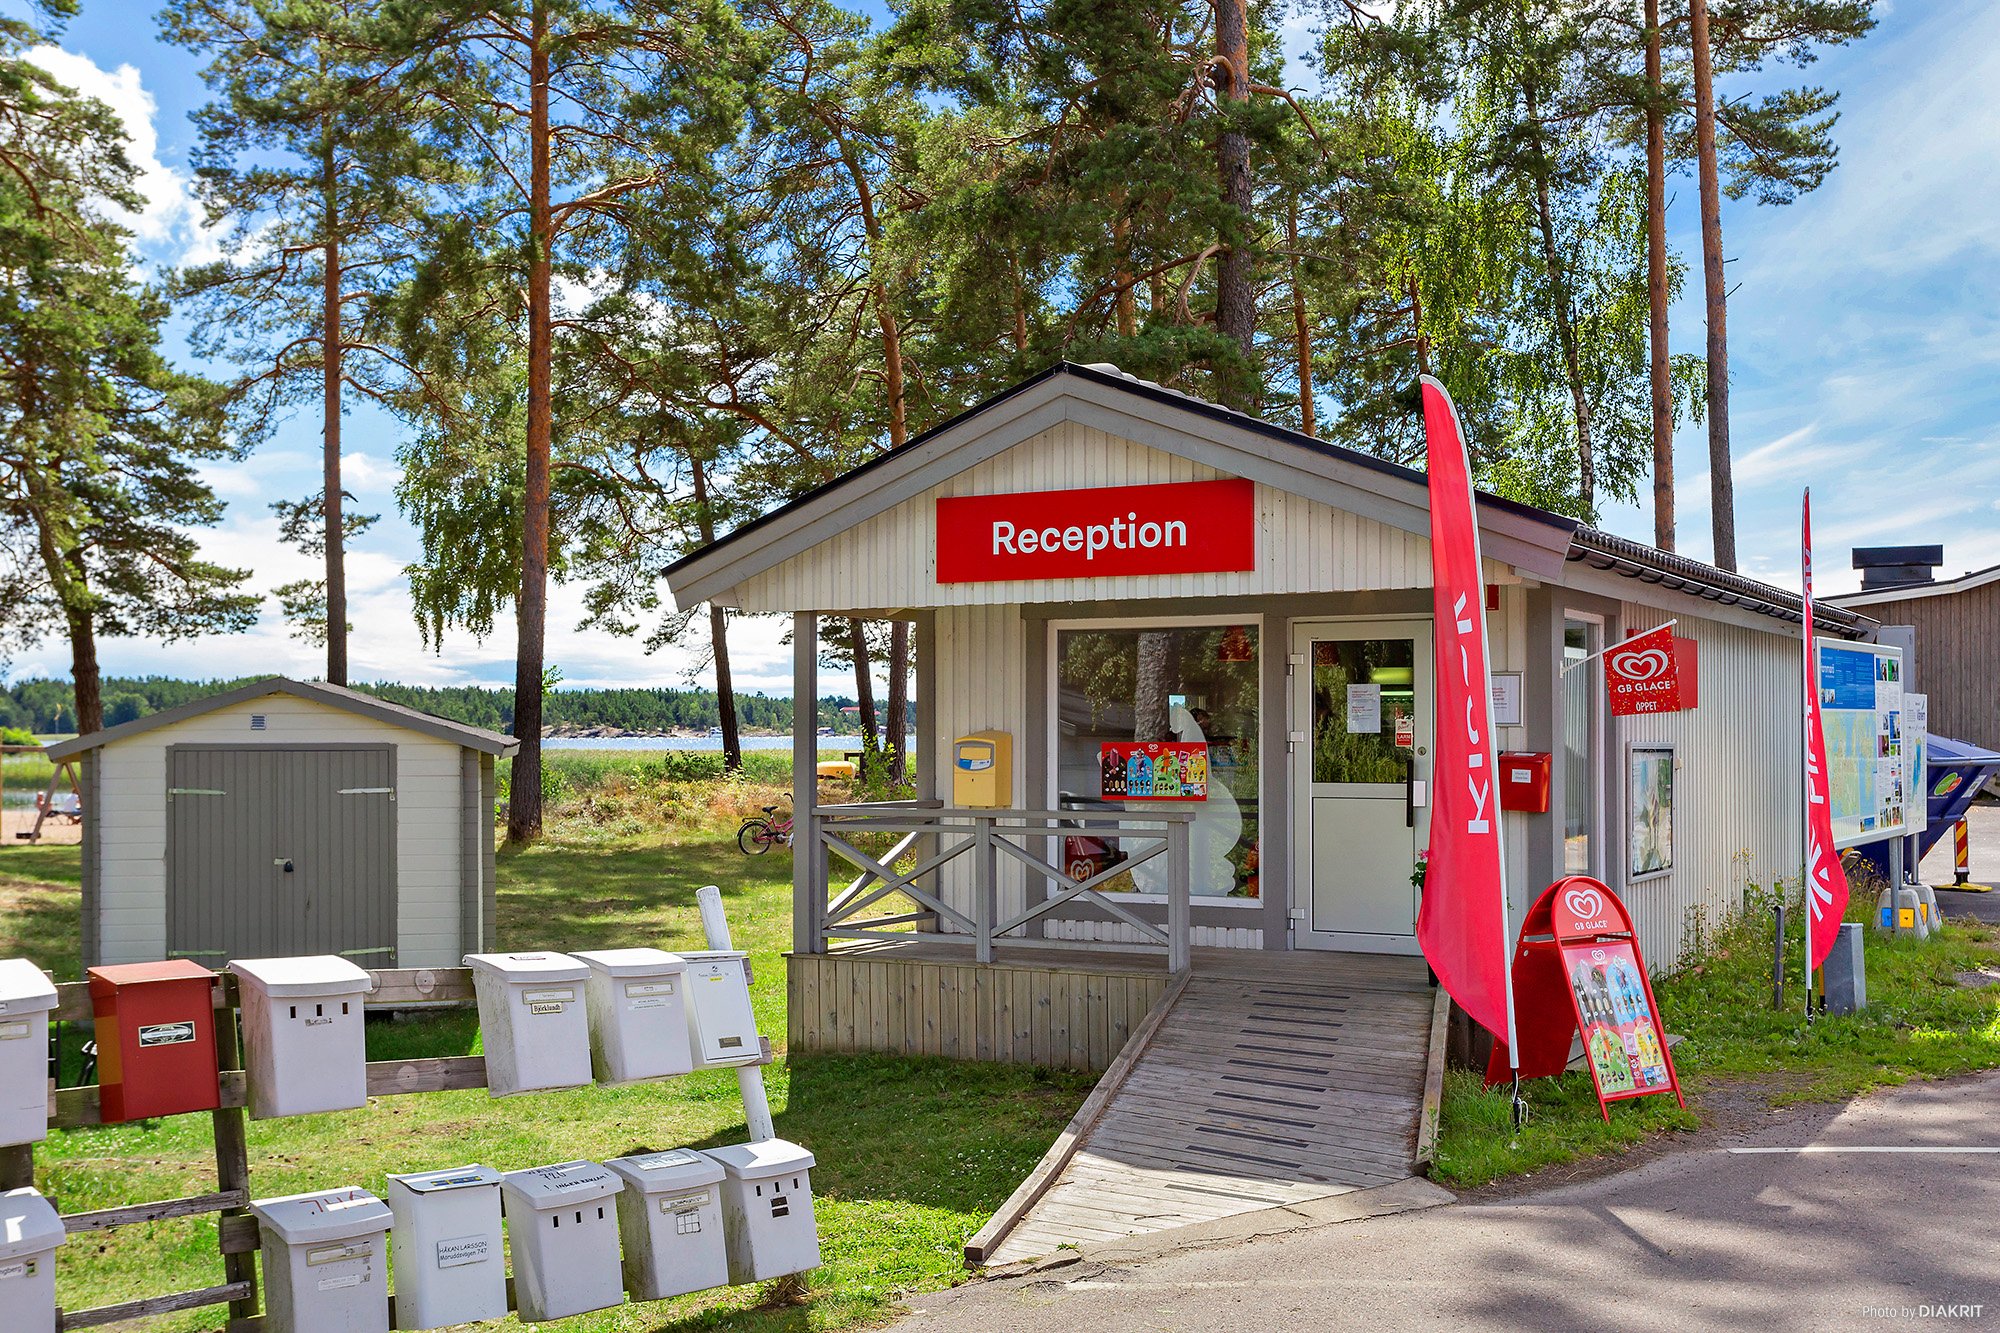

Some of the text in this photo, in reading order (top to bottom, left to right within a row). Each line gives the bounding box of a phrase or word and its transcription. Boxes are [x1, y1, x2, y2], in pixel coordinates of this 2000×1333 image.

[993, 512, 1187, 560] Reception
[1617, 680, 1671, 694] GB GLACE
[1635, 701, 1658, 712] ÖPPET
[1574, 919, 1607, 931] GB GLACE
[299, 1190, 369, 1213] 746
[439, 1241, 488, 1254] HÅKAN LARSSON
[477, 1247, 488, 1255] 747
